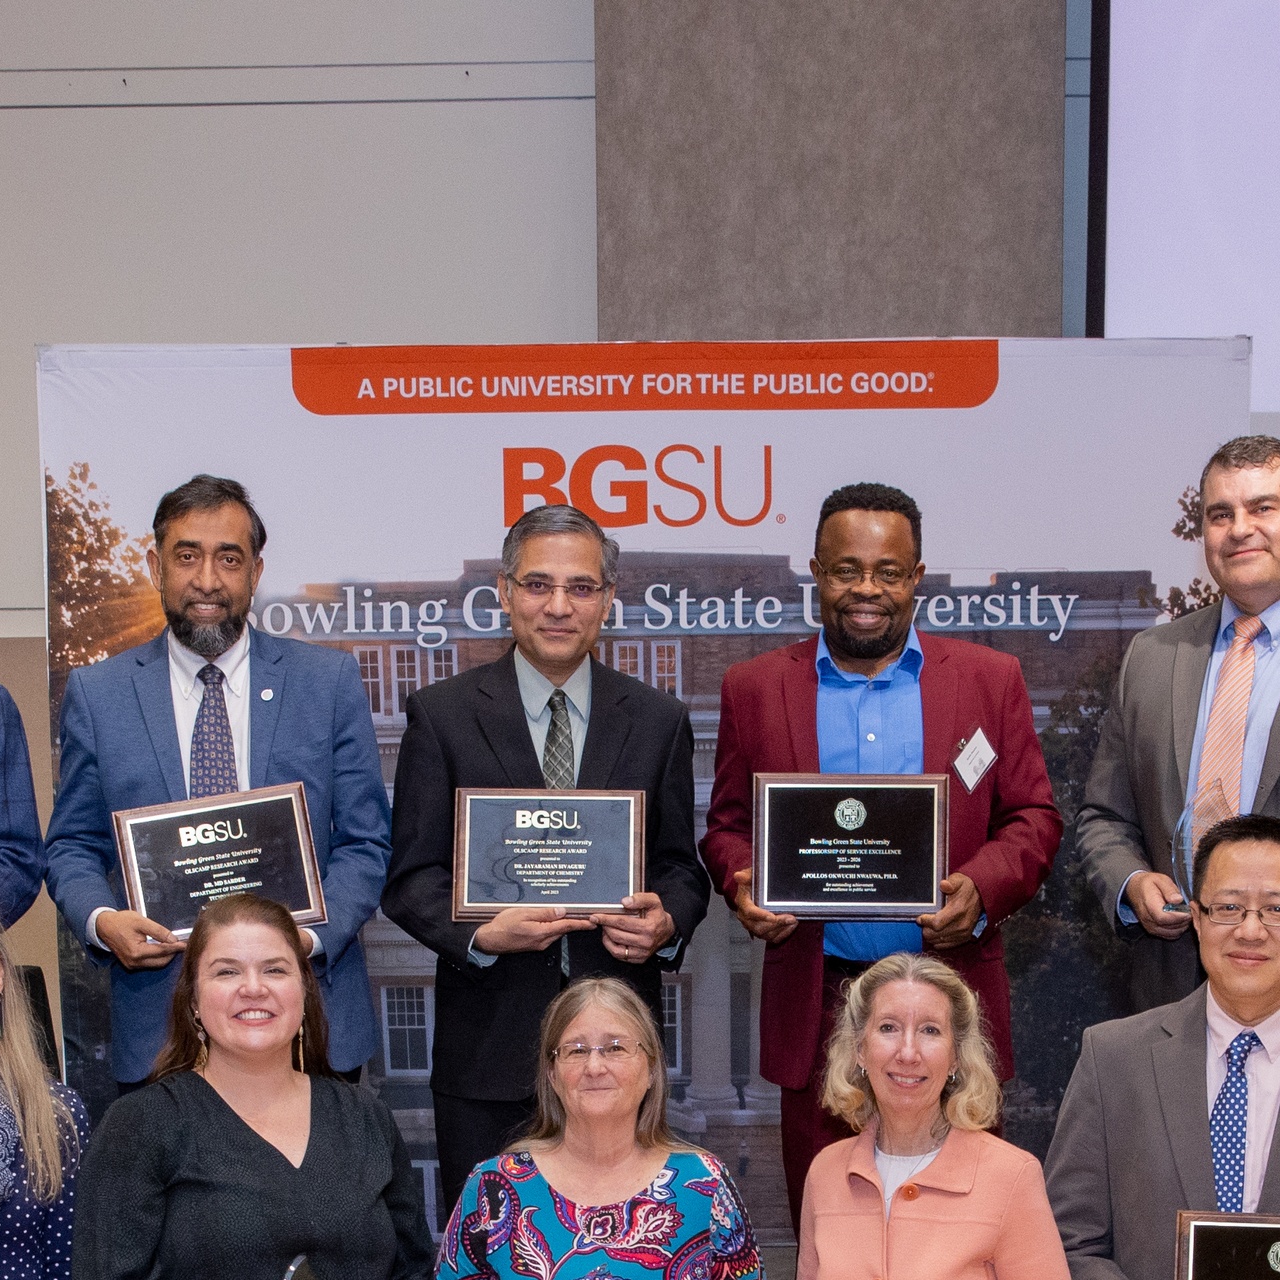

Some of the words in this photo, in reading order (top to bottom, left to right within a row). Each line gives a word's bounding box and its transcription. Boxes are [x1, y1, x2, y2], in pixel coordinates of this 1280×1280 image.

[358, 379, 376, 399] A
[383, 377, 474, 398] PUBLIC
[482, 374, 634, 398] UNIVERSITY
[643, 374, 692, 395] FOR
[696, 374, 746, 395] THE
[753, 373, 843, 395] PUBLIC
[247, 586, 448, 648] owling
[644, 583, 783, 631] State
[798, 582, 1079, 642] Uversity
